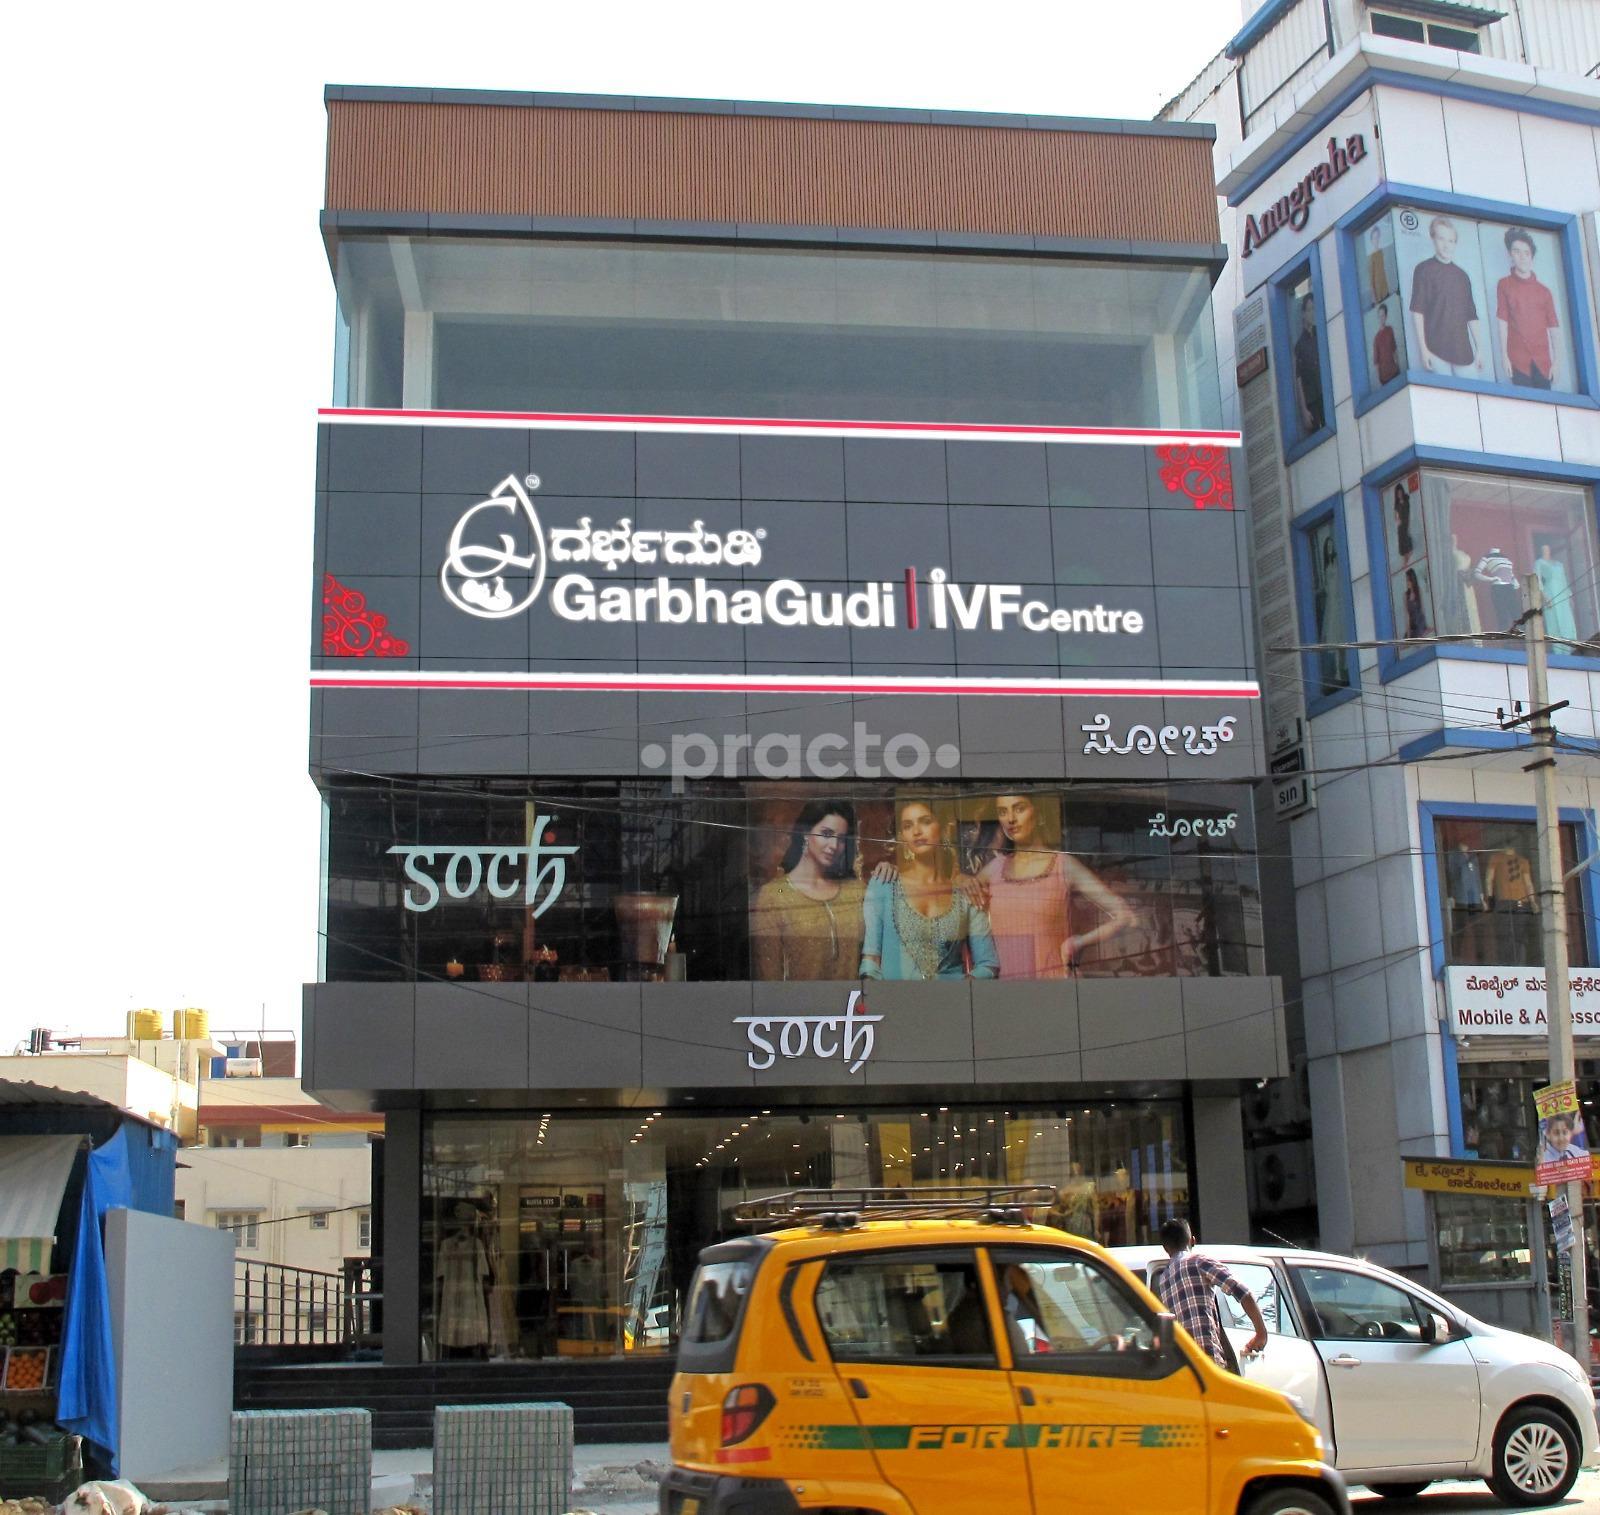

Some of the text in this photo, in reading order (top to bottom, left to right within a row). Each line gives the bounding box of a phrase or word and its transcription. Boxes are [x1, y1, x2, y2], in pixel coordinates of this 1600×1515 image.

[1241, 134, 1367, 258] Anugraha
[552, 574, 895, 628] GarbhaGudi
[1081, 713, 1237, 755] ಸೋಚ್
[1149, 813, 1238, 837] ಸೋಚ್
[1458, 1009, 1600, 1025] Mobile & Asso
[907, 1425, 1142, 1450] FOR HIRE
